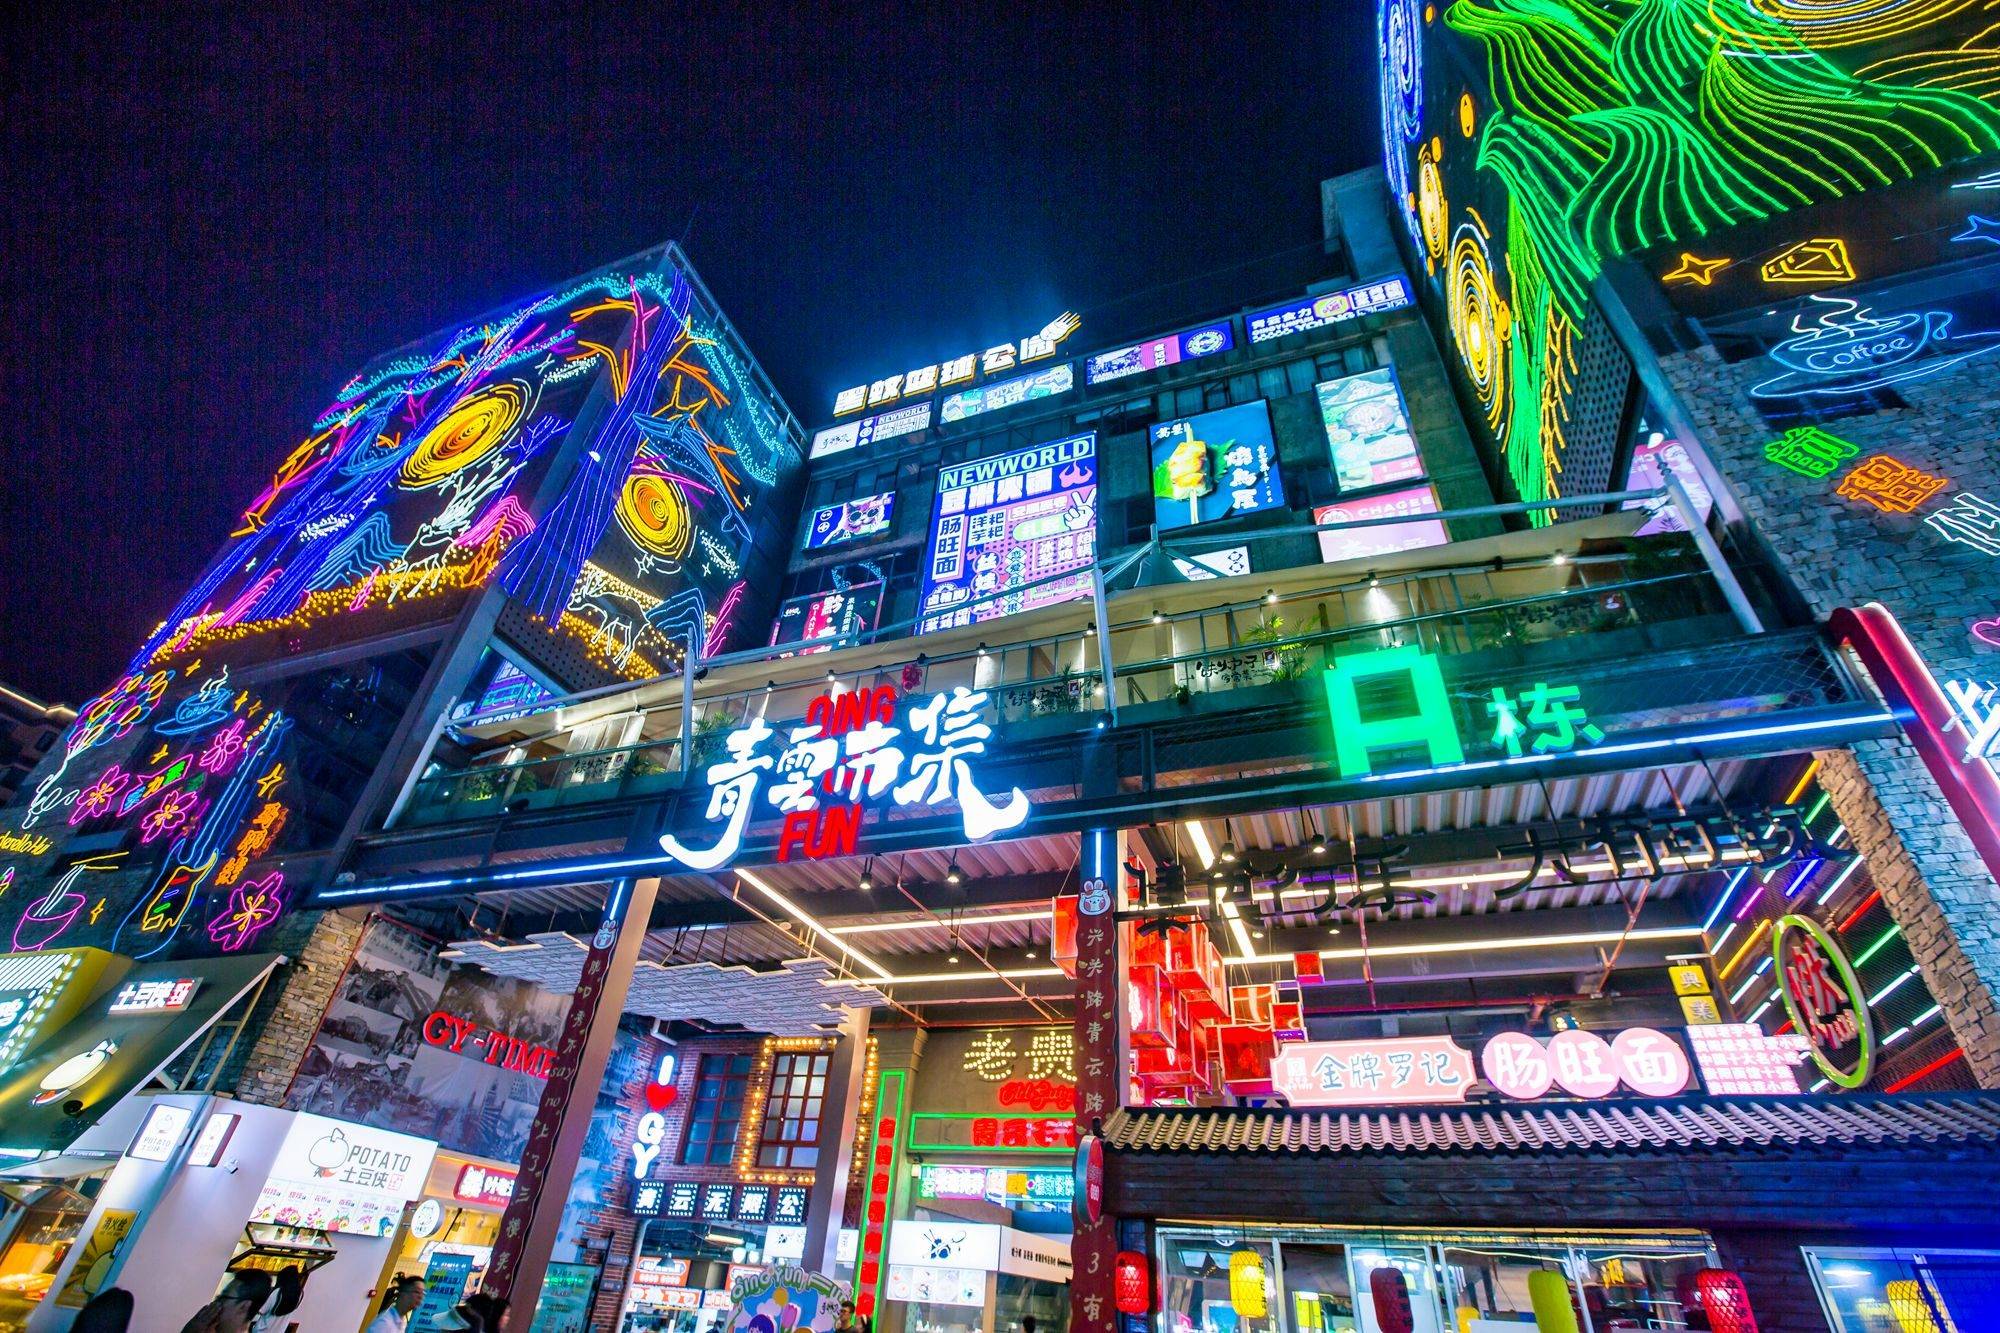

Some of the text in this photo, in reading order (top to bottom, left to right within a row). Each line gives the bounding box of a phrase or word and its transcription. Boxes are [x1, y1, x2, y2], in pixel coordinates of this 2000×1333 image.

[1806, 335, 1914, 371] Coffee
[943, 440, 1090, 490] NEWWORLD
[1358, 495, 1435, 518] CHAGEE
[935, 519, 962, 575] 肠旺面
[776, 802, 867, 863] FUN
[550, 1066, 576, 1081] say
[657, 1054, 675, 1087] I
[1313, 1052, 1460, 1090] 金牌罗记
[1496, 1031, 1679, 1090] 肠旺面
[544, 1096, 562, 1108] no
[347, 1144, 412, 1173] POTATO
[338, 1166, 390, 1189] 土豆侠
